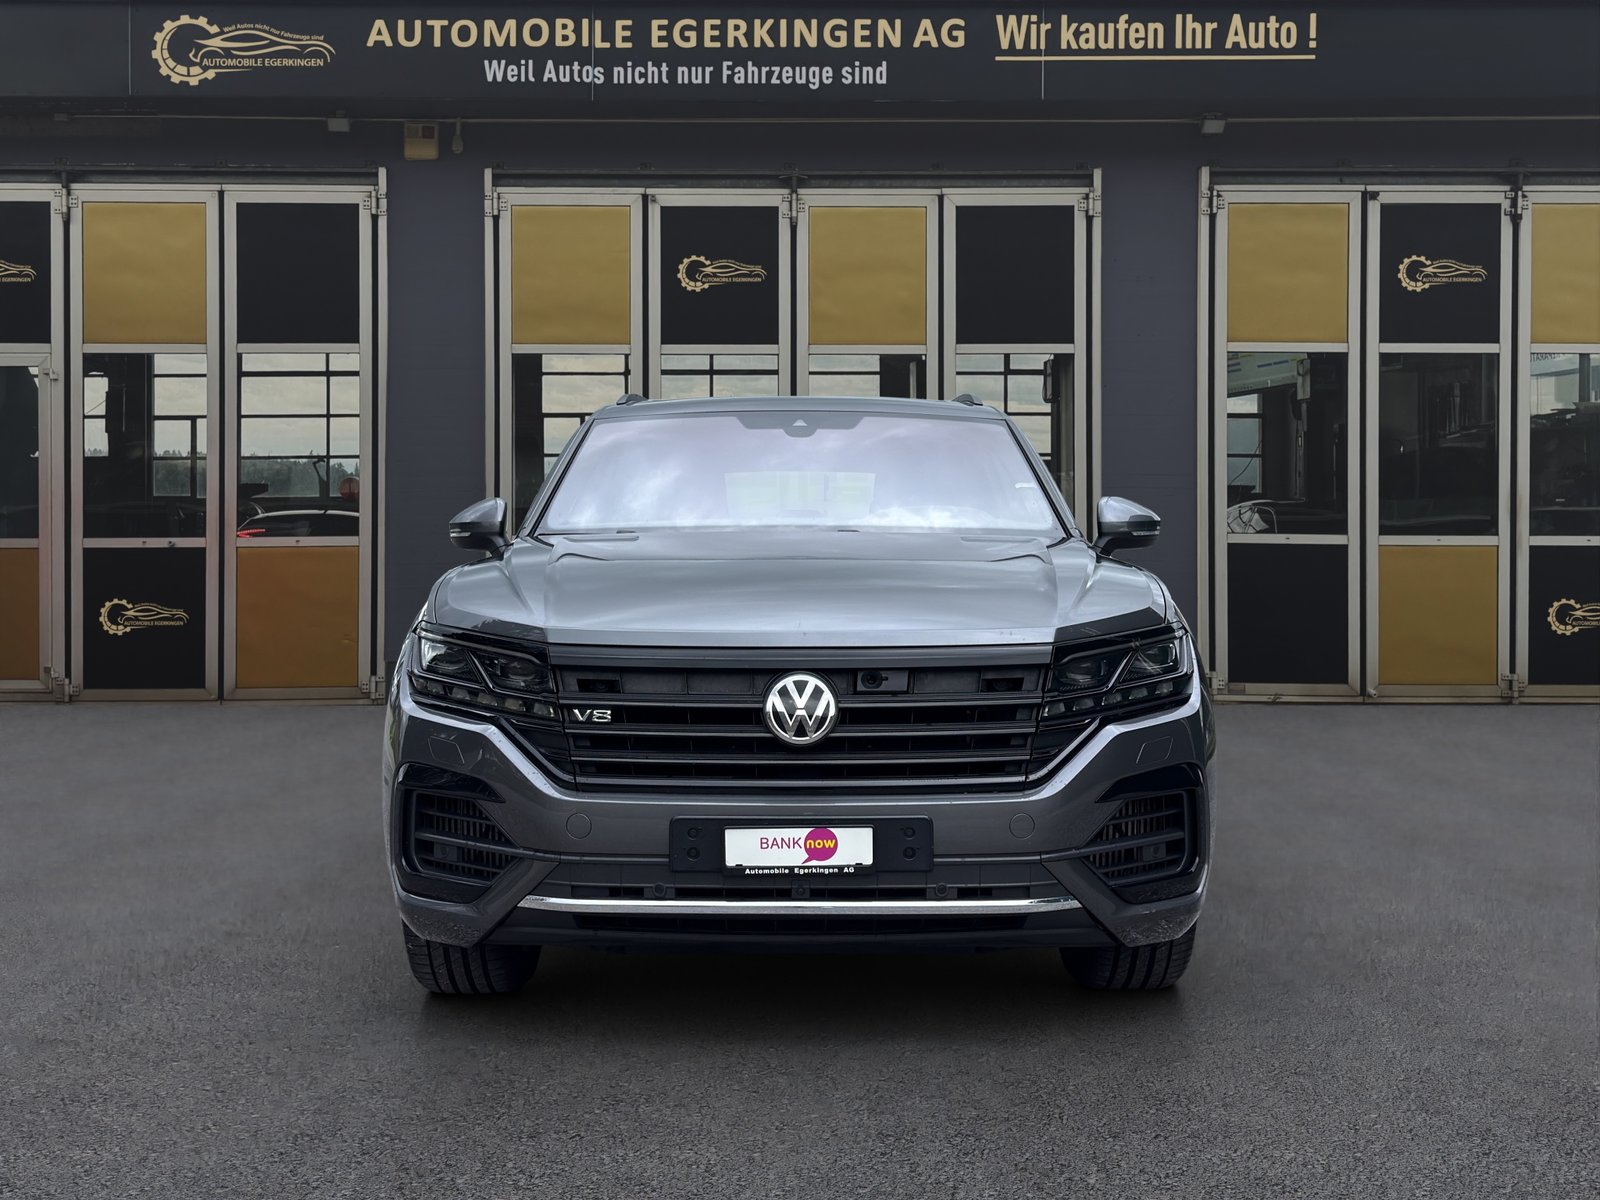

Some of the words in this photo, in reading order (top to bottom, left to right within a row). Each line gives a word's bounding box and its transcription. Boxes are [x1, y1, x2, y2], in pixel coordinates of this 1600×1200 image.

[223, 25, 236, 33] Weil
[366, 18, 633, 49] AUTOMOBILE
[651, 18, 901, 49] EGERKINGEN
[912, 18, 966, 49] AG
[995, 14, 1052, 50] Wir
[1060, 13, 1165, 50] kaufen
[1174, 13, 1218, 50] Ihr
[1224, 13, 1298, 50] Auto
[1308, 12, 1317, 49] !
[202, 58, 263, 67] AUTOMOBILE
[265, 58, 324, 67] EGERKINGEN
[484, 59, 535, 83] Weil
[542, 59, 605, 84] Autos
[613, 61, 669, 84] nicht
[677, 65, 714, 84] nur
[722, 60, 834, 90] Fahrzeuge
[841, 60, 887, 85] sind
[572, 708, 612, 722] V8
[760, 837, 802, 849] BANK
[806, 839, 836, 849] now
[794, 867, 839, 875] Egerkingen
